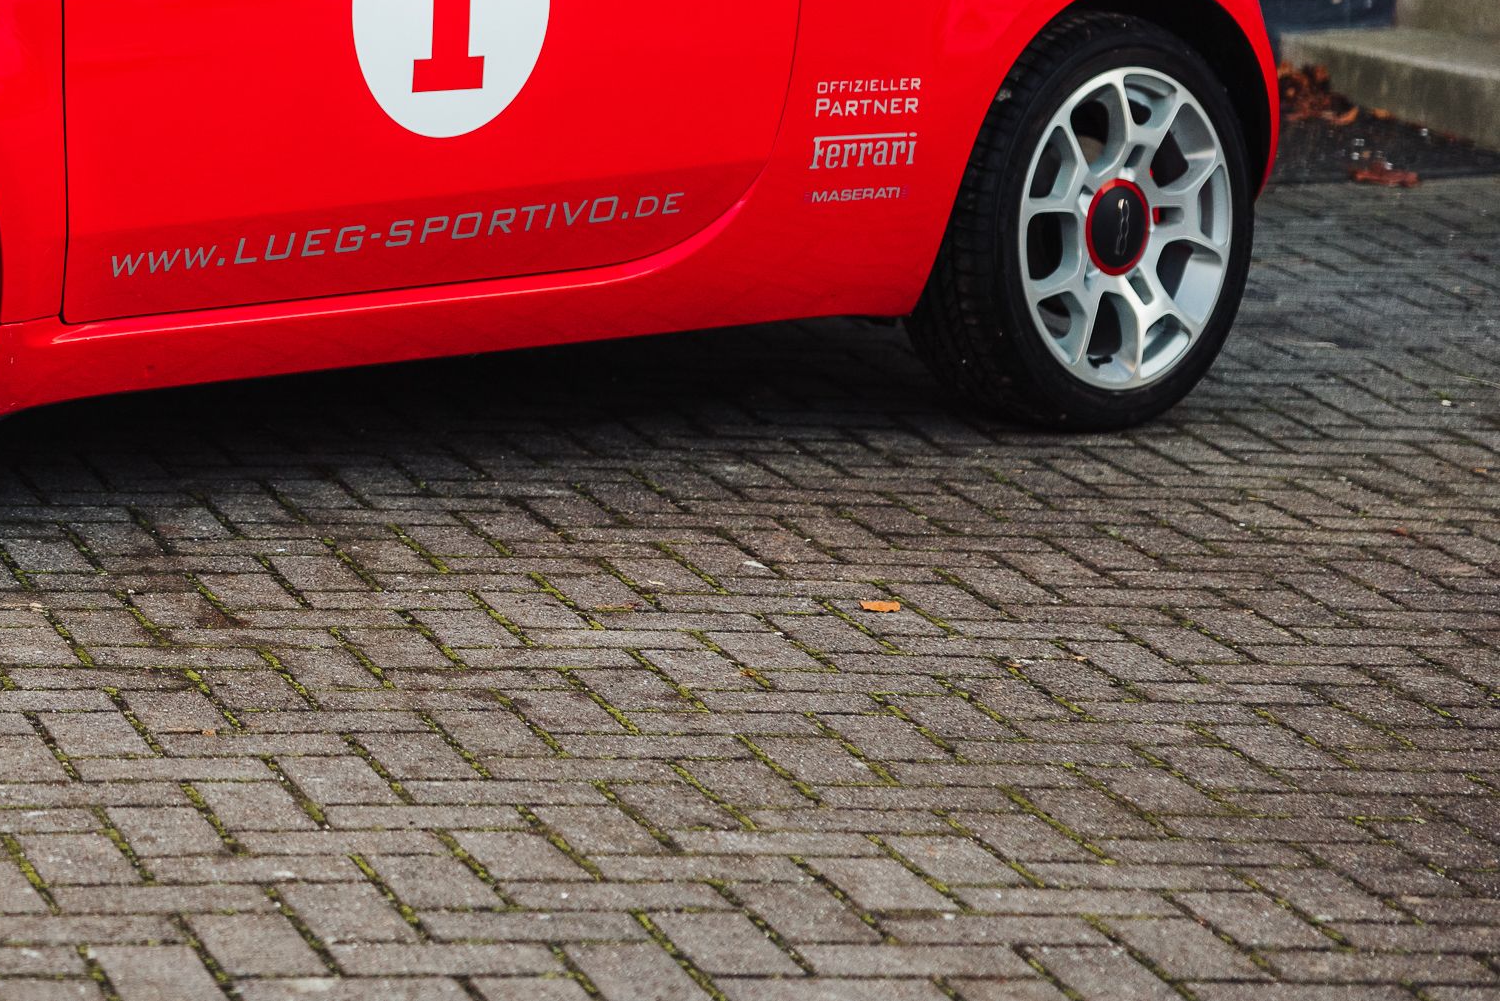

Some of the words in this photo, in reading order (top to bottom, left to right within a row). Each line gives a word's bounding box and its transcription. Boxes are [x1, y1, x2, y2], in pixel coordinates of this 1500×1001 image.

[817, 78, 921, 94] OFFIZIELLER
[815, 98, 918, 118] PARTNER
[809, 132, 917, 169] Ferrari
[811, 186, 901, 203] MASERATI
